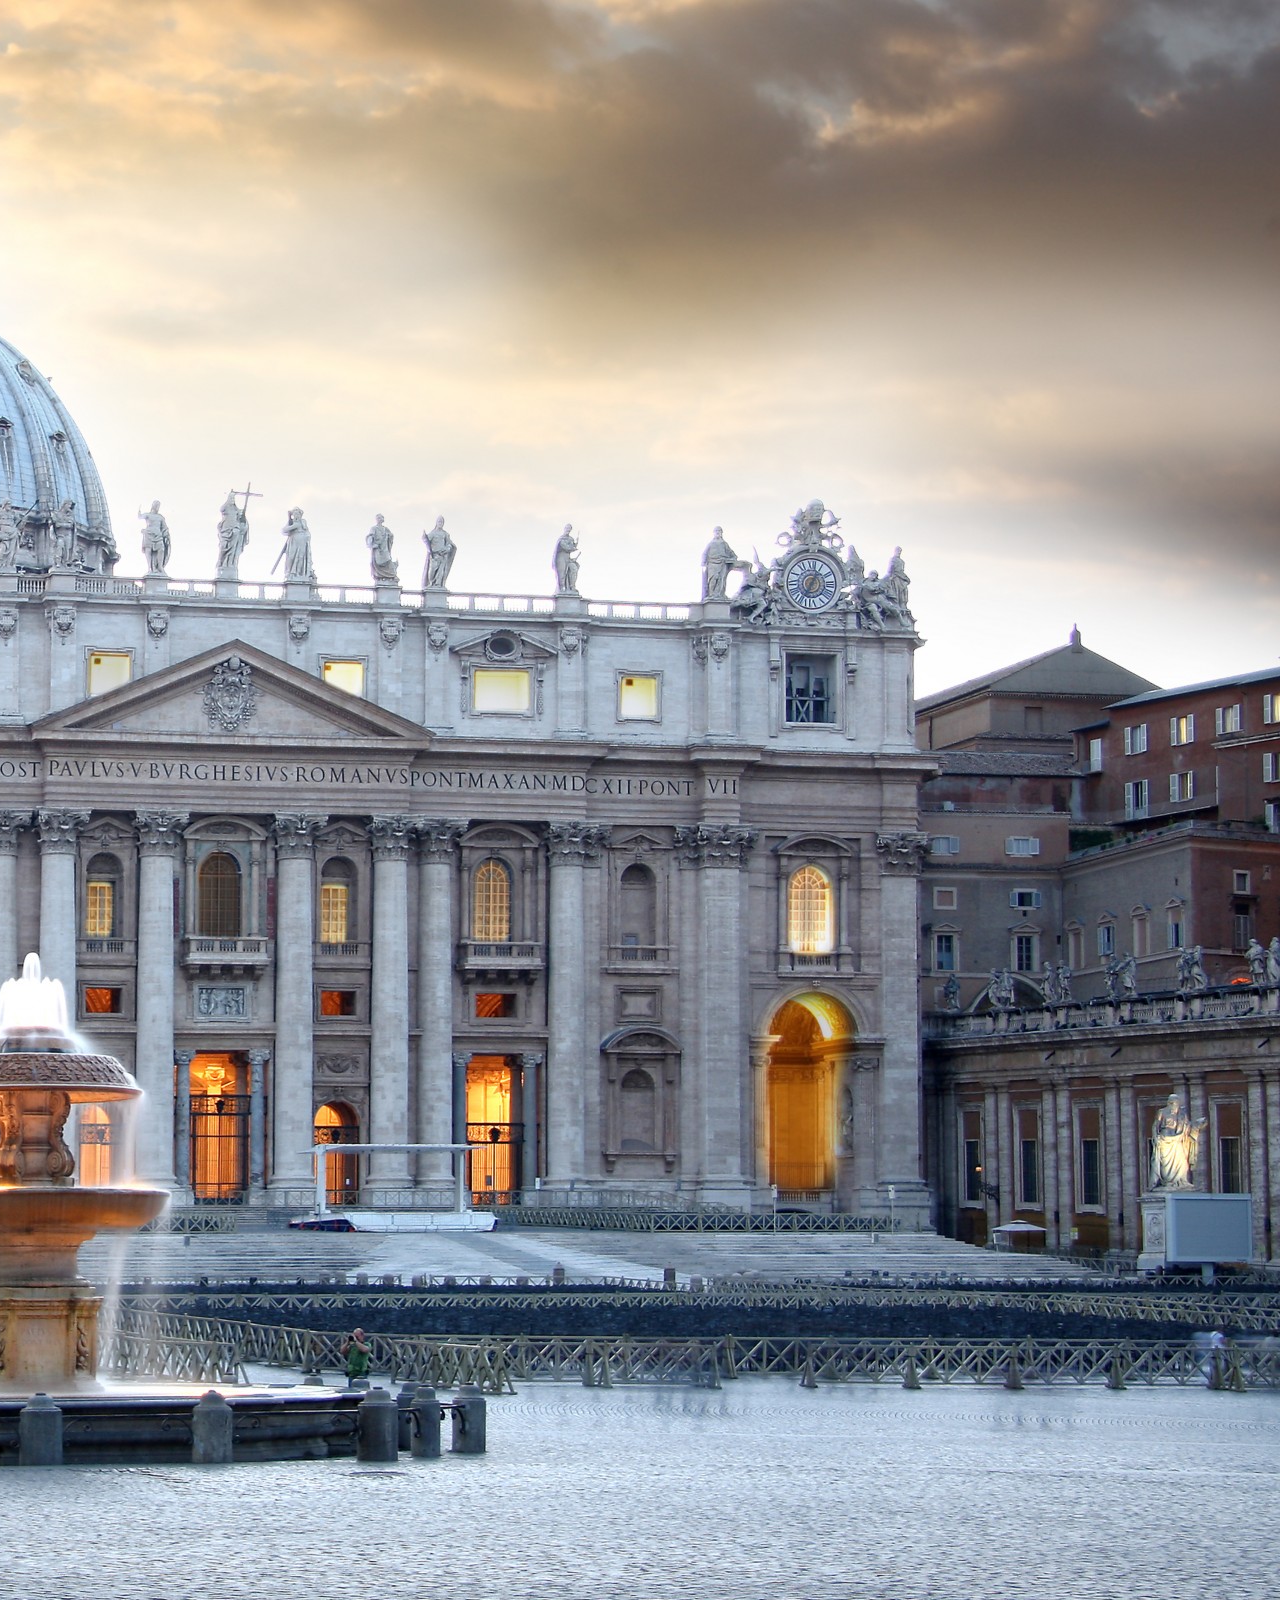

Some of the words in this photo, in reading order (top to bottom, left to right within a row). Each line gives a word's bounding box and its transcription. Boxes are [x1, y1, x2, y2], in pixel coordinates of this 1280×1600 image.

[48, 759, 125, 779] PAVLVS
[129, 762, 144, 778] V
[148, 762, 289, 783] BVRGHESIVS
[295, 766, 408, 785] ROMANVS
[409, 770, 467, 788] PONT
[468, 772, 518, 790] MAX
[517, 774, 547, 791] AN
[551, 774, 632, 795] MDCXII
[638, 779, 695, 797] PONT
[707, 778, 738, 795] VII
